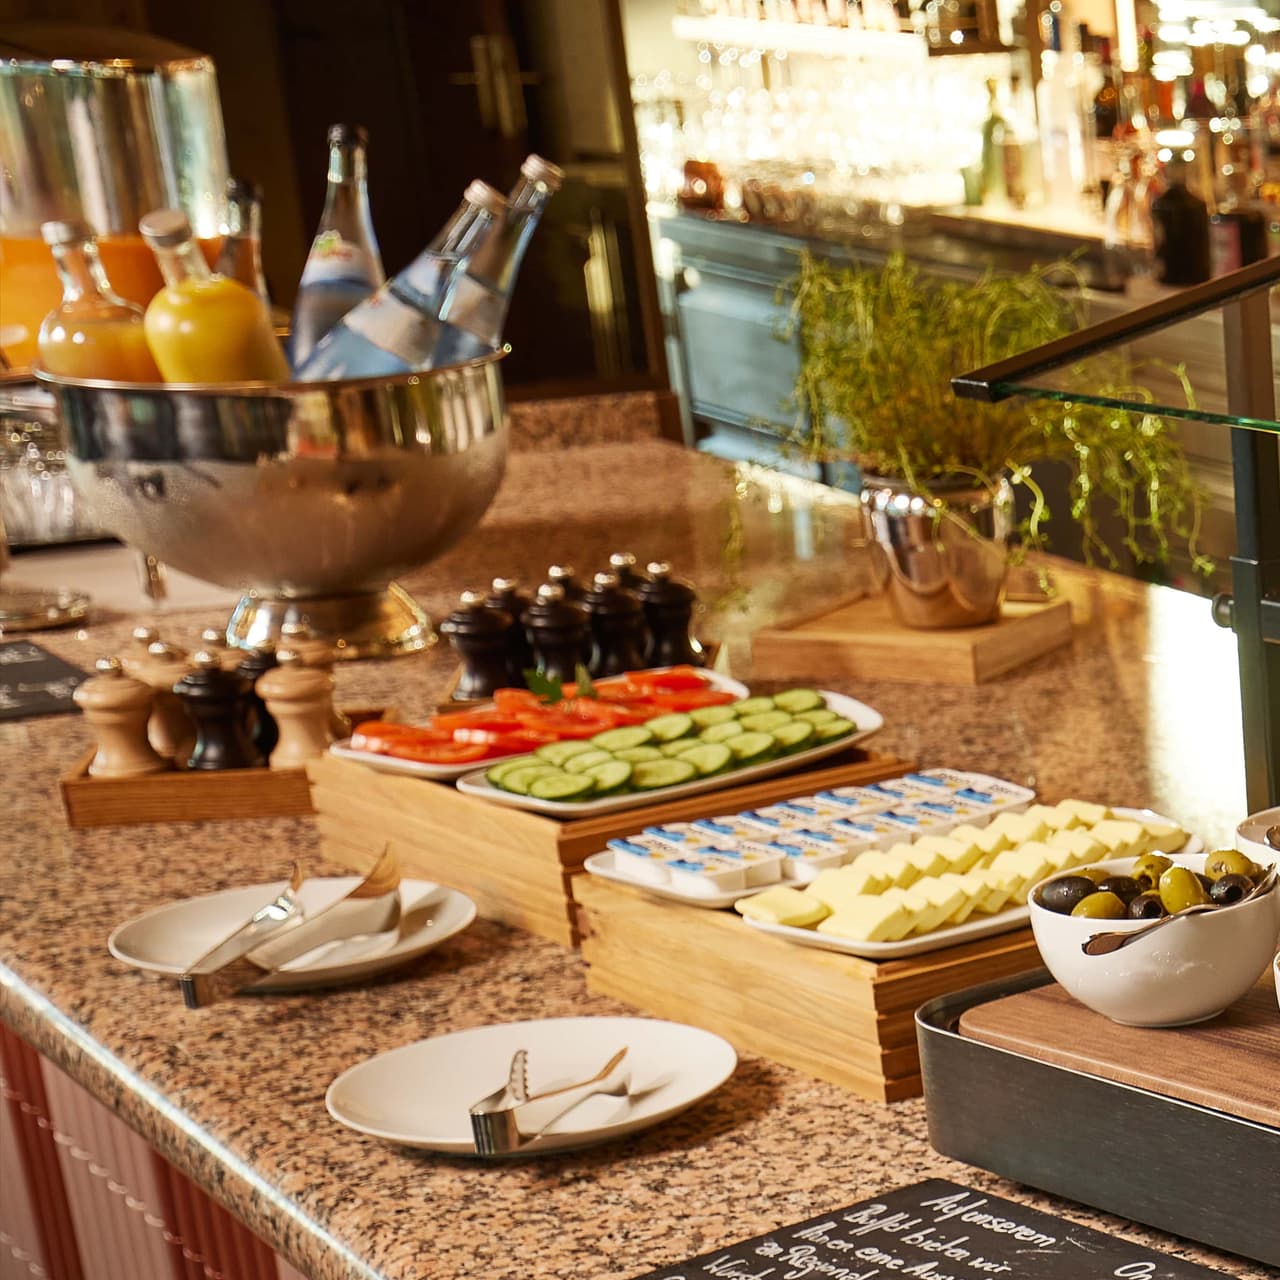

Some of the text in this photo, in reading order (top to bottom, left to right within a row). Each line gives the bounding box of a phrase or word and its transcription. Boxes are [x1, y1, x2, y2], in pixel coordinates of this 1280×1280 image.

[792, 1221, 854, 1252] Ihnen
[855, 1247, 905, 1269] eine
[843, 1204, 1012, 1272] Buffet bieten wir
[920, 1192, 1056, 1247] Auf unserem
[755, 1241, 784, 1258] an
